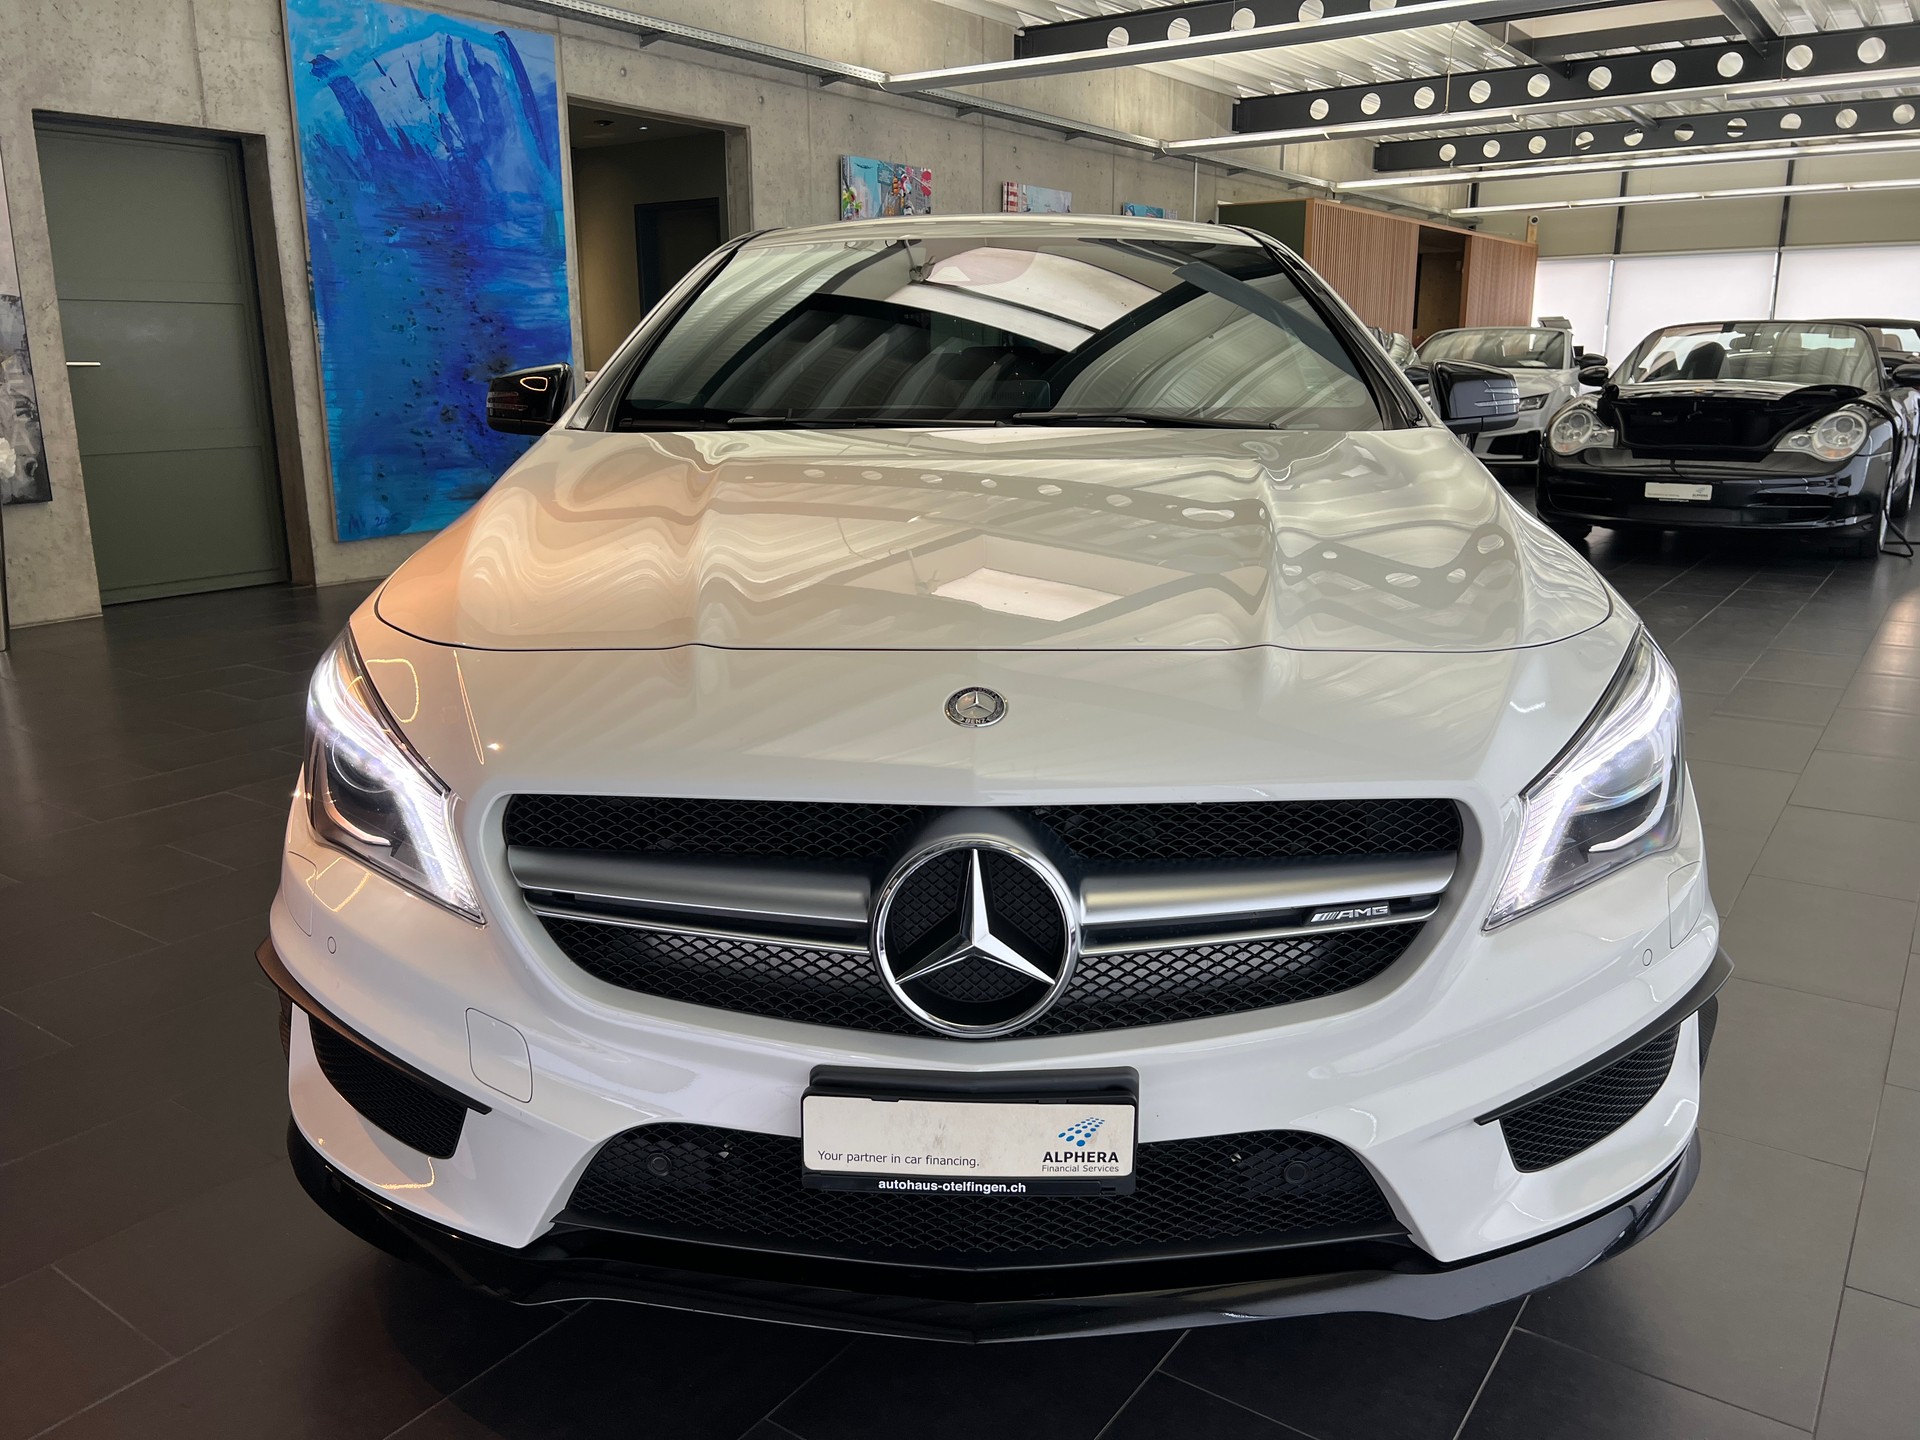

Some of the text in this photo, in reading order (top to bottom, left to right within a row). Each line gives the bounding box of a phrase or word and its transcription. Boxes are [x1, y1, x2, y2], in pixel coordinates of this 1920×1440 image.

[1336, 906, 1389, 920] AMG
[818, 1150, 980, 1168] Your partner in car financing.
[1042, 1151, 1119, 1163] ALPHERA
[1041, 1164, 1119, 1173] Financial Services
[878, 1179, 1026, 1194] autohaus-otelfingen.ch
